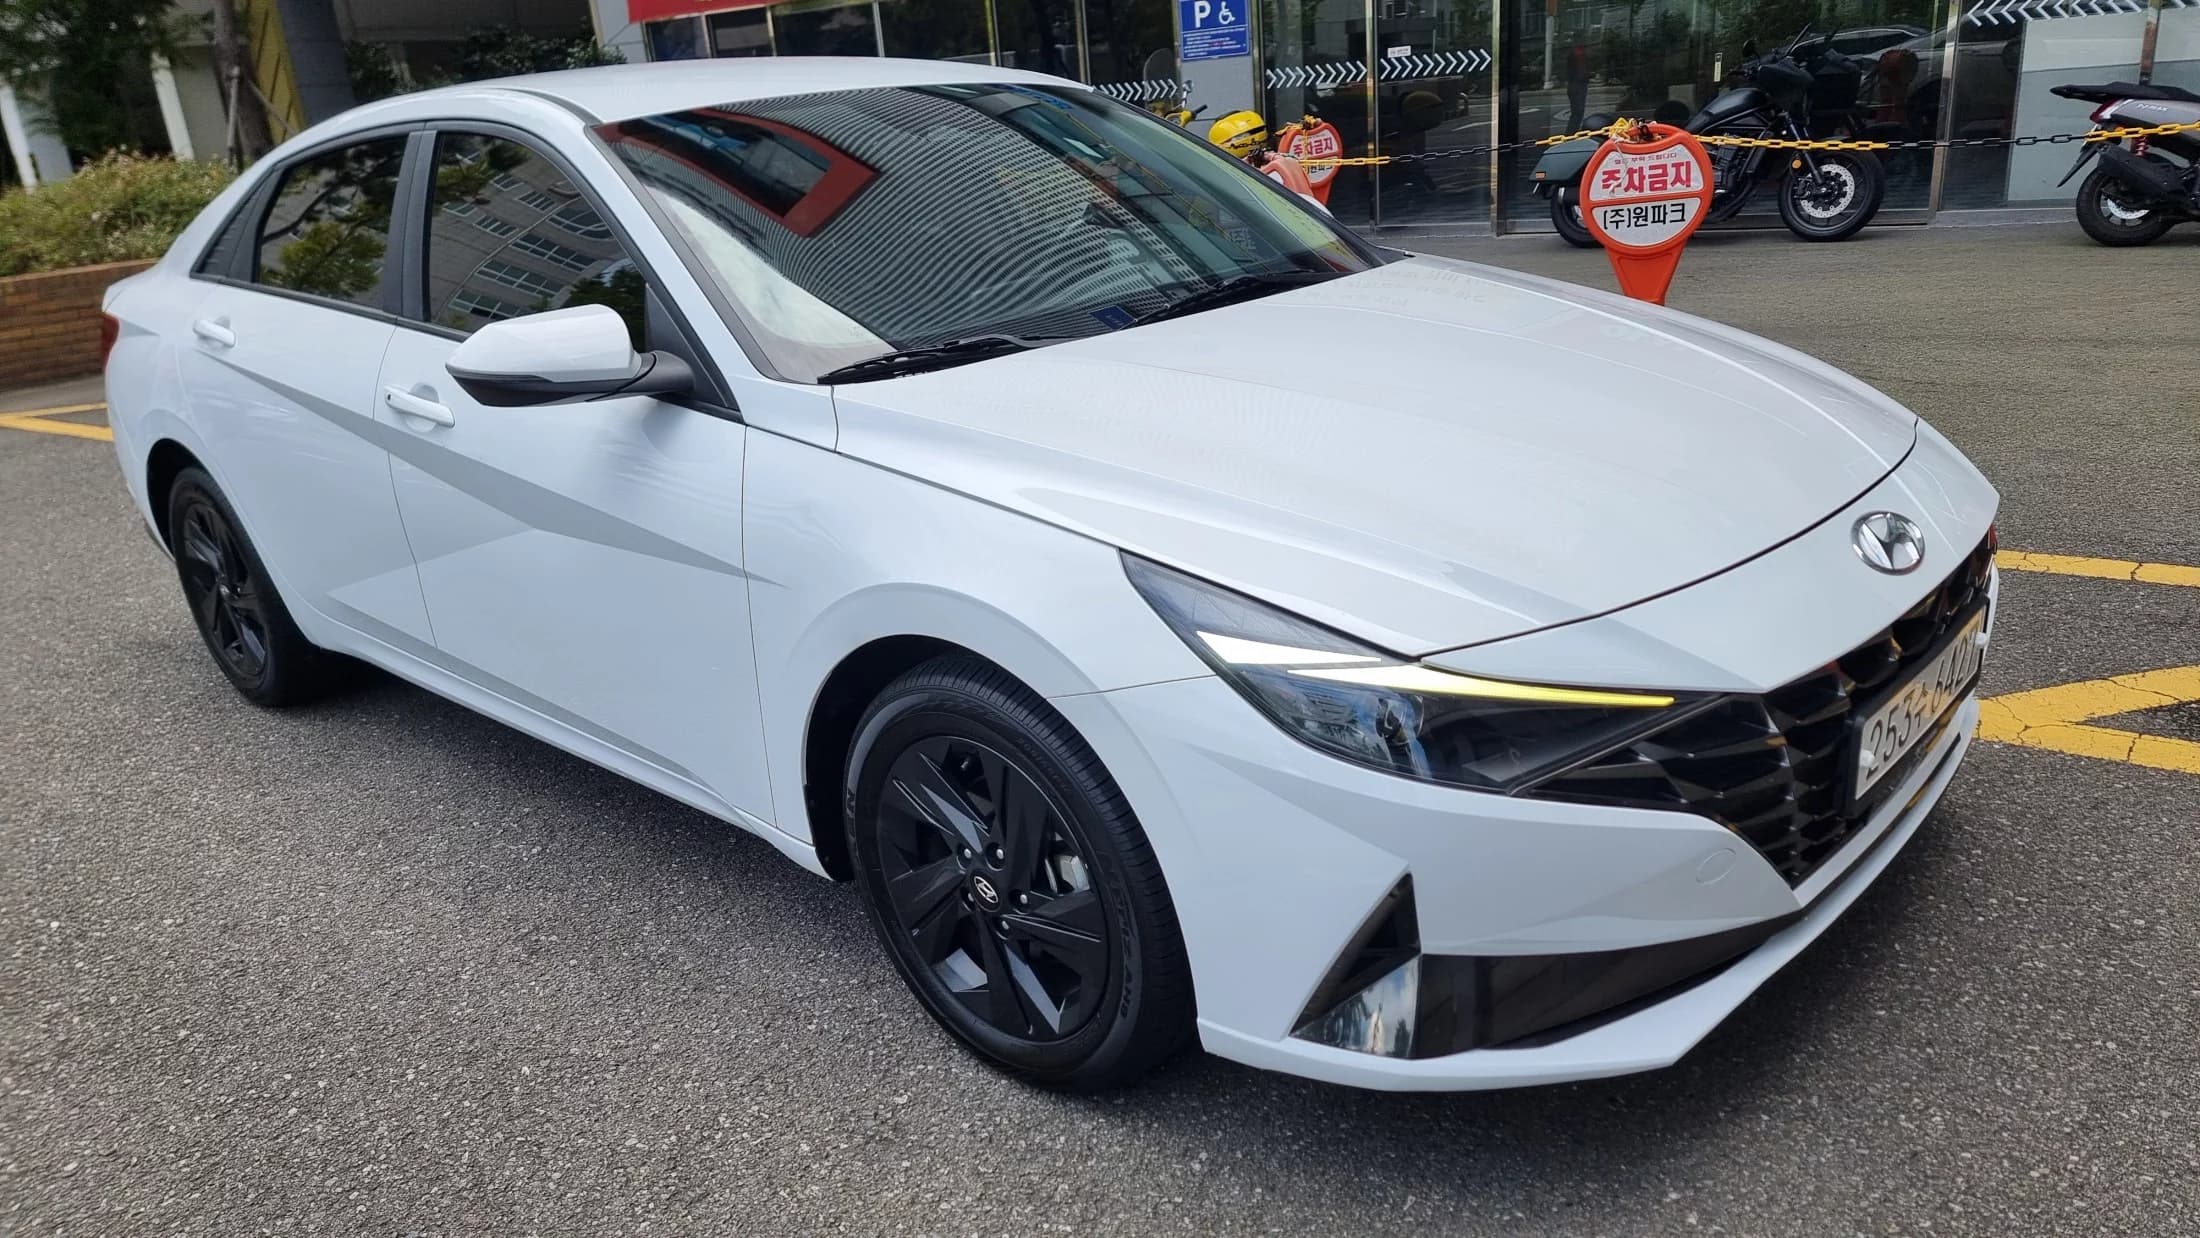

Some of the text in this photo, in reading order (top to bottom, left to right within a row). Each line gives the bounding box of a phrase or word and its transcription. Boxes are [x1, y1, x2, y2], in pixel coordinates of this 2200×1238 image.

[1194, 0, 1211, 28] P
[1601, 161, 1691, 194] 주차금지
[1603, 203, 1686, 230] (주)원파크
